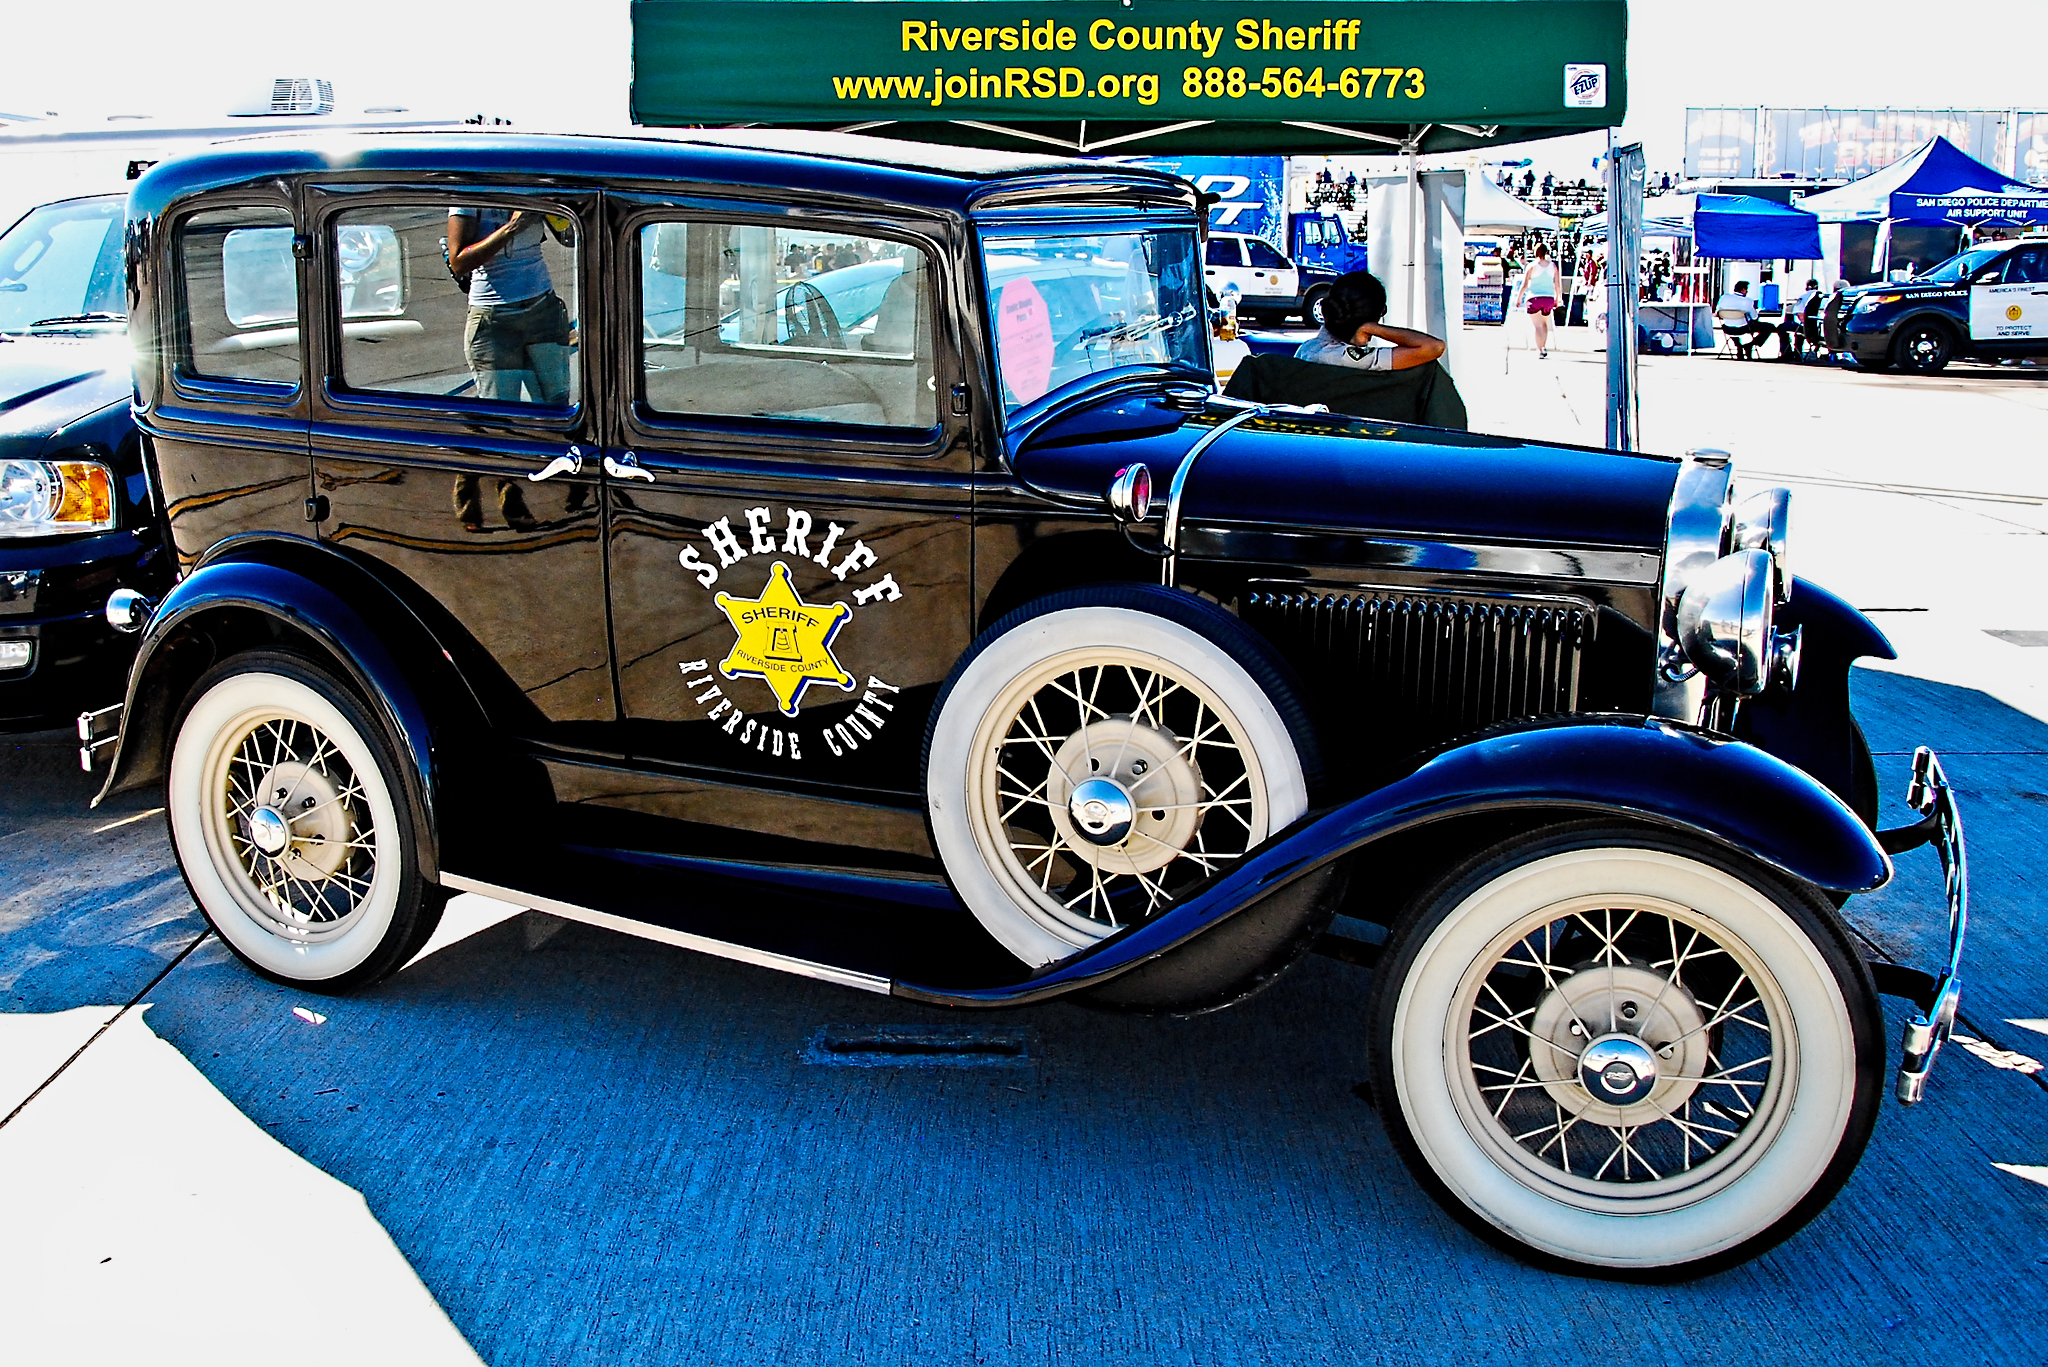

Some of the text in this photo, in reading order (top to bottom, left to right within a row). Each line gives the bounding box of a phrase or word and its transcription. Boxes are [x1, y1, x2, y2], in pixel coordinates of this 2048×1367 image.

[902, 17, 1361, 58] Riverside County Sheriff
[832, 65, 1425, 107] www.joinRSD.org 888-564-6773
[1916, 198, 1936, 207] SAN
[1937, 198, 1966, 207] DIEGO
[1967, 198, 1999, 207] POLICE
[1946, 208, 2029, 219] AIR SUPPORT UNIT
[1943, 290, 1969, 298] POLICE
[678, 506, 903, 607] SHERIFF
[741, 606, 820, 629] SHERIFF
[736, 649, 830, 673] RIVERSIDE COUNTY
[678, 658, 901, 760] RIVERSIDE COUNTY
